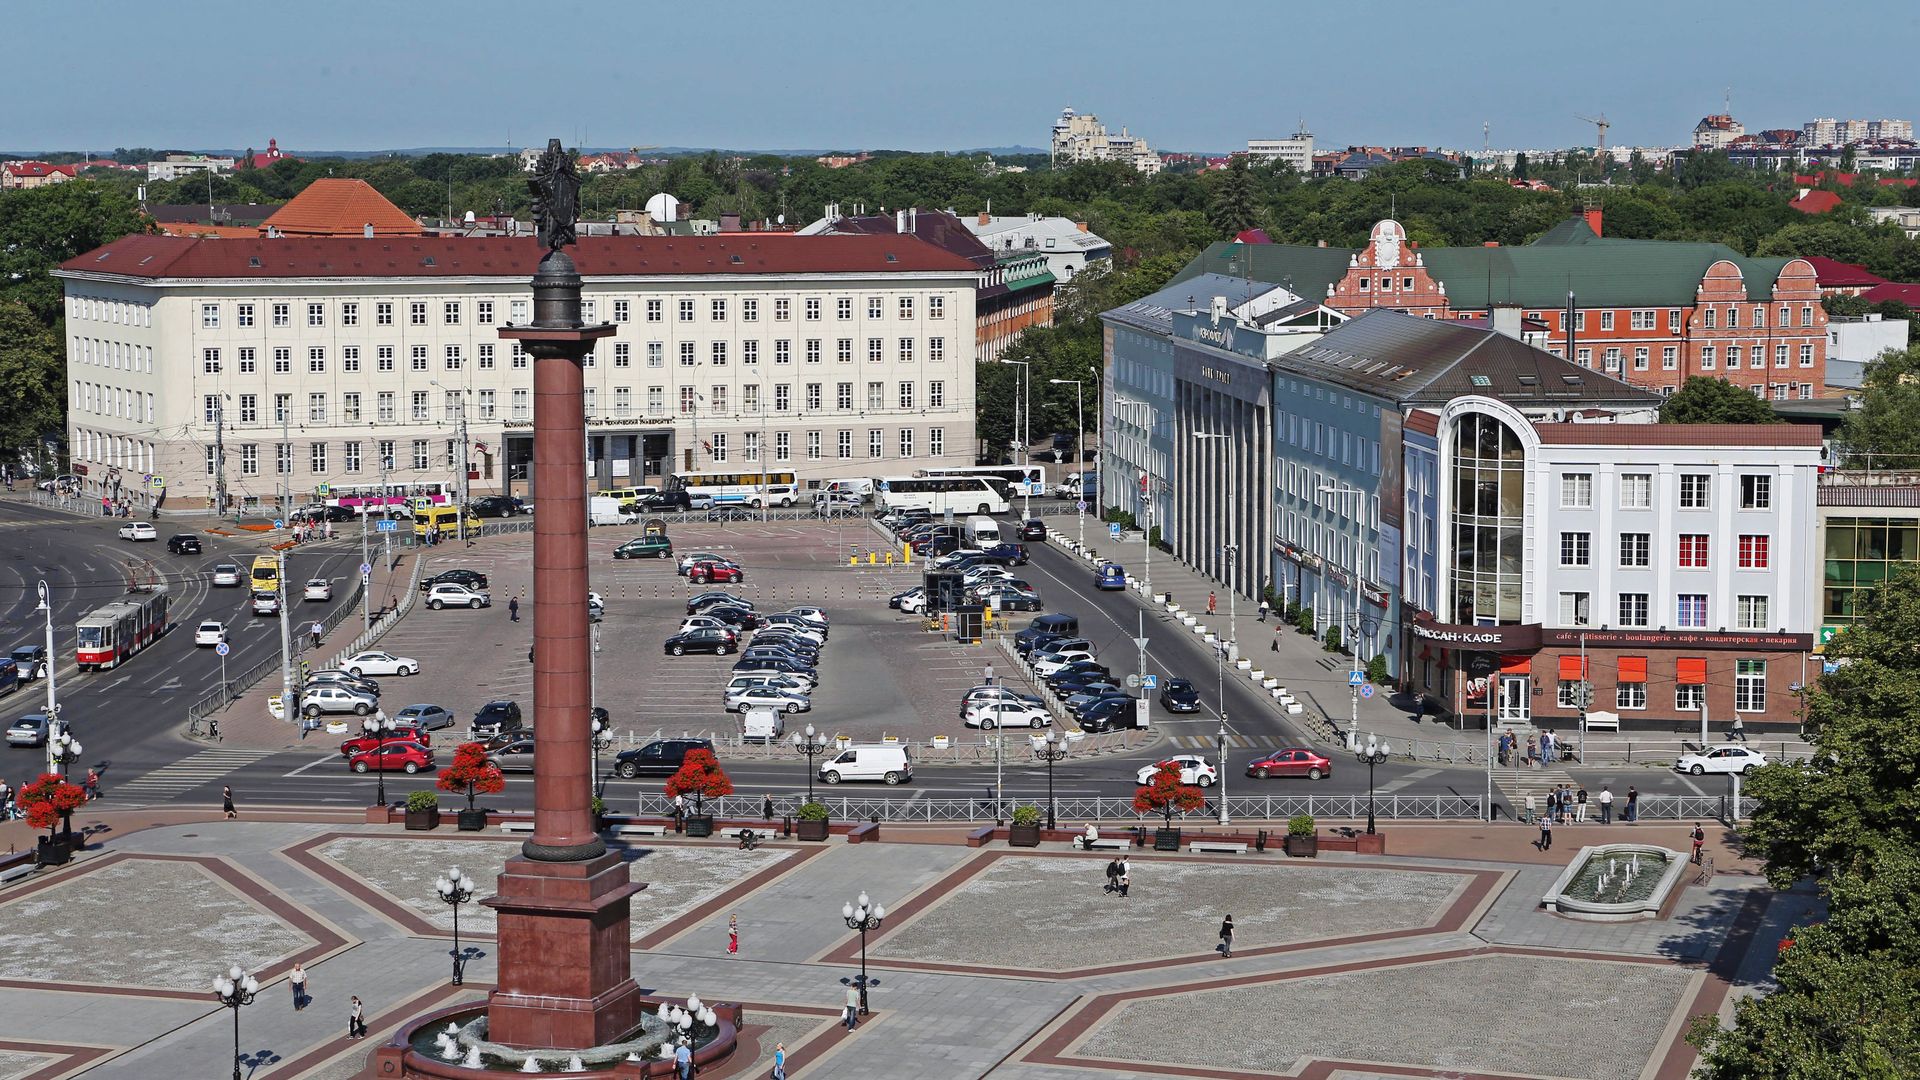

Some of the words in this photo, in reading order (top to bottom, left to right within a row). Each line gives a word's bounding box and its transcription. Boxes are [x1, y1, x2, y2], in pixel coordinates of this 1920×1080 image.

[1462, 633, 1502, 643] КАФЕ
[1556, 632, 1572, 640] café
[1625, 633, 1671, 643] boulangerie
[1679, 635, 1698, 643] кафе
[1705, 636, 1758, 644] кондитерская
